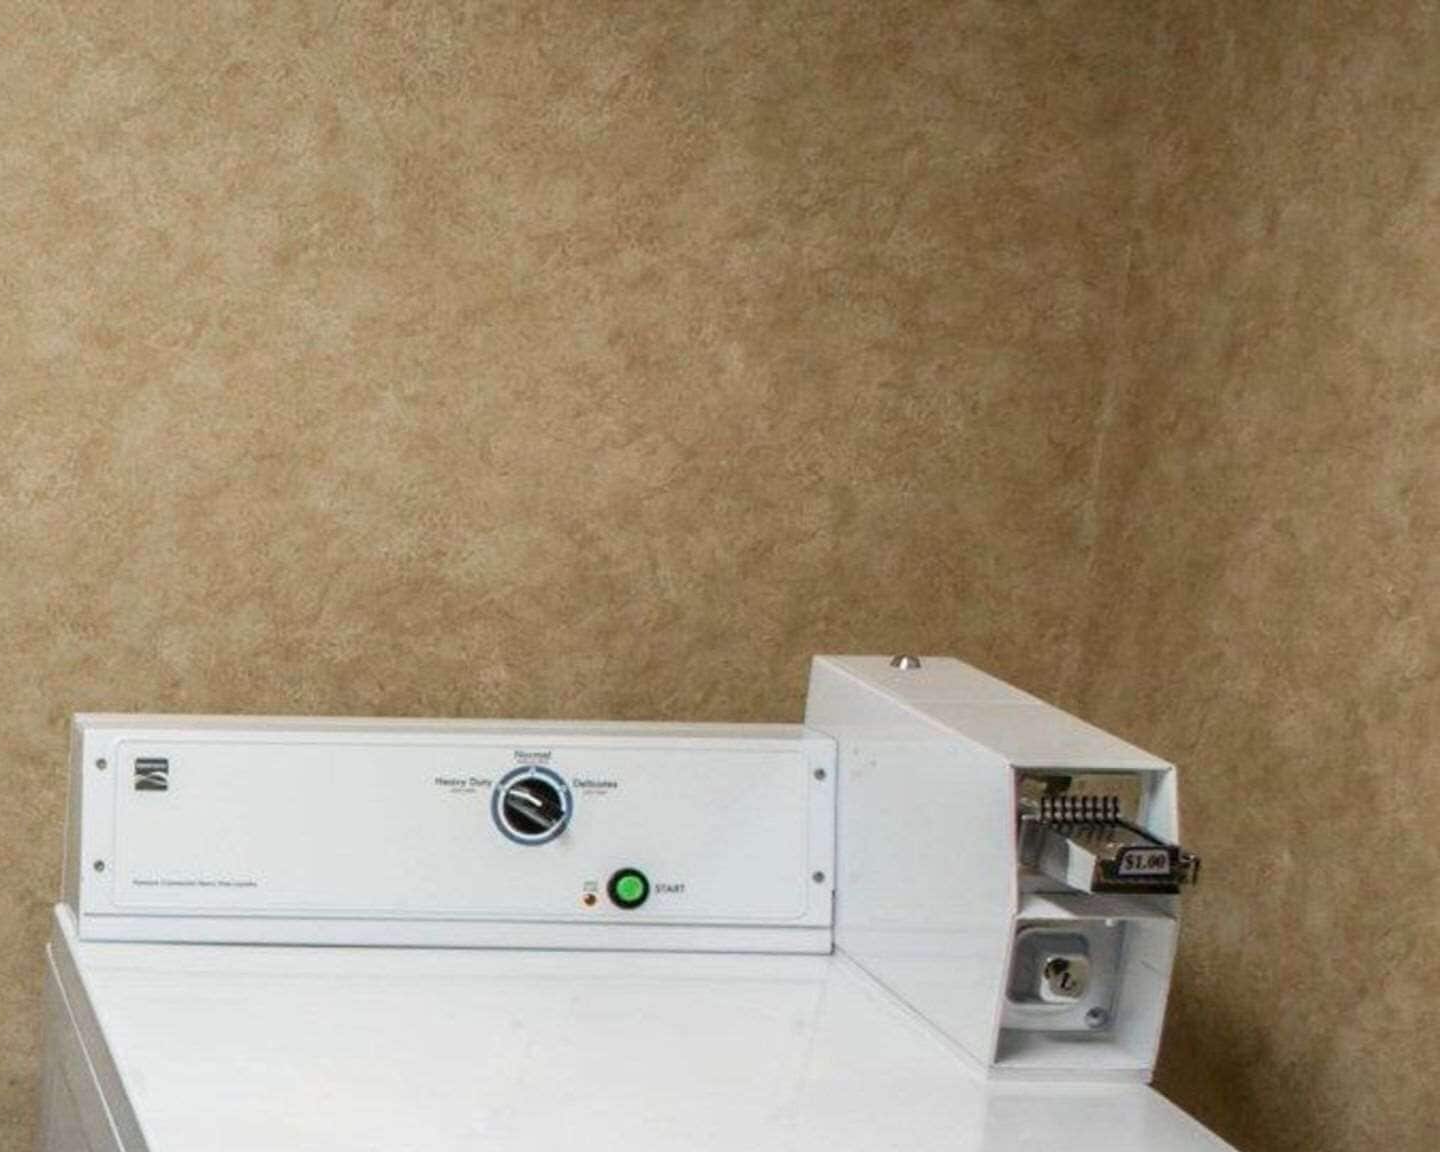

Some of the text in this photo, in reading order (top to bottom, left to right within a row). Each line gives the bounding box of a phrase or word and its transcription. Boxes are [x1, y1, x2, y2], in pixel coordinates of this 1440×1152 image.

[514, 750, 552, 759] Normal
[435, 777, 492, 787] Heavy Duty
[1124, 854, 1166, 870] $1.00
[655, 883, 685, 893] START
